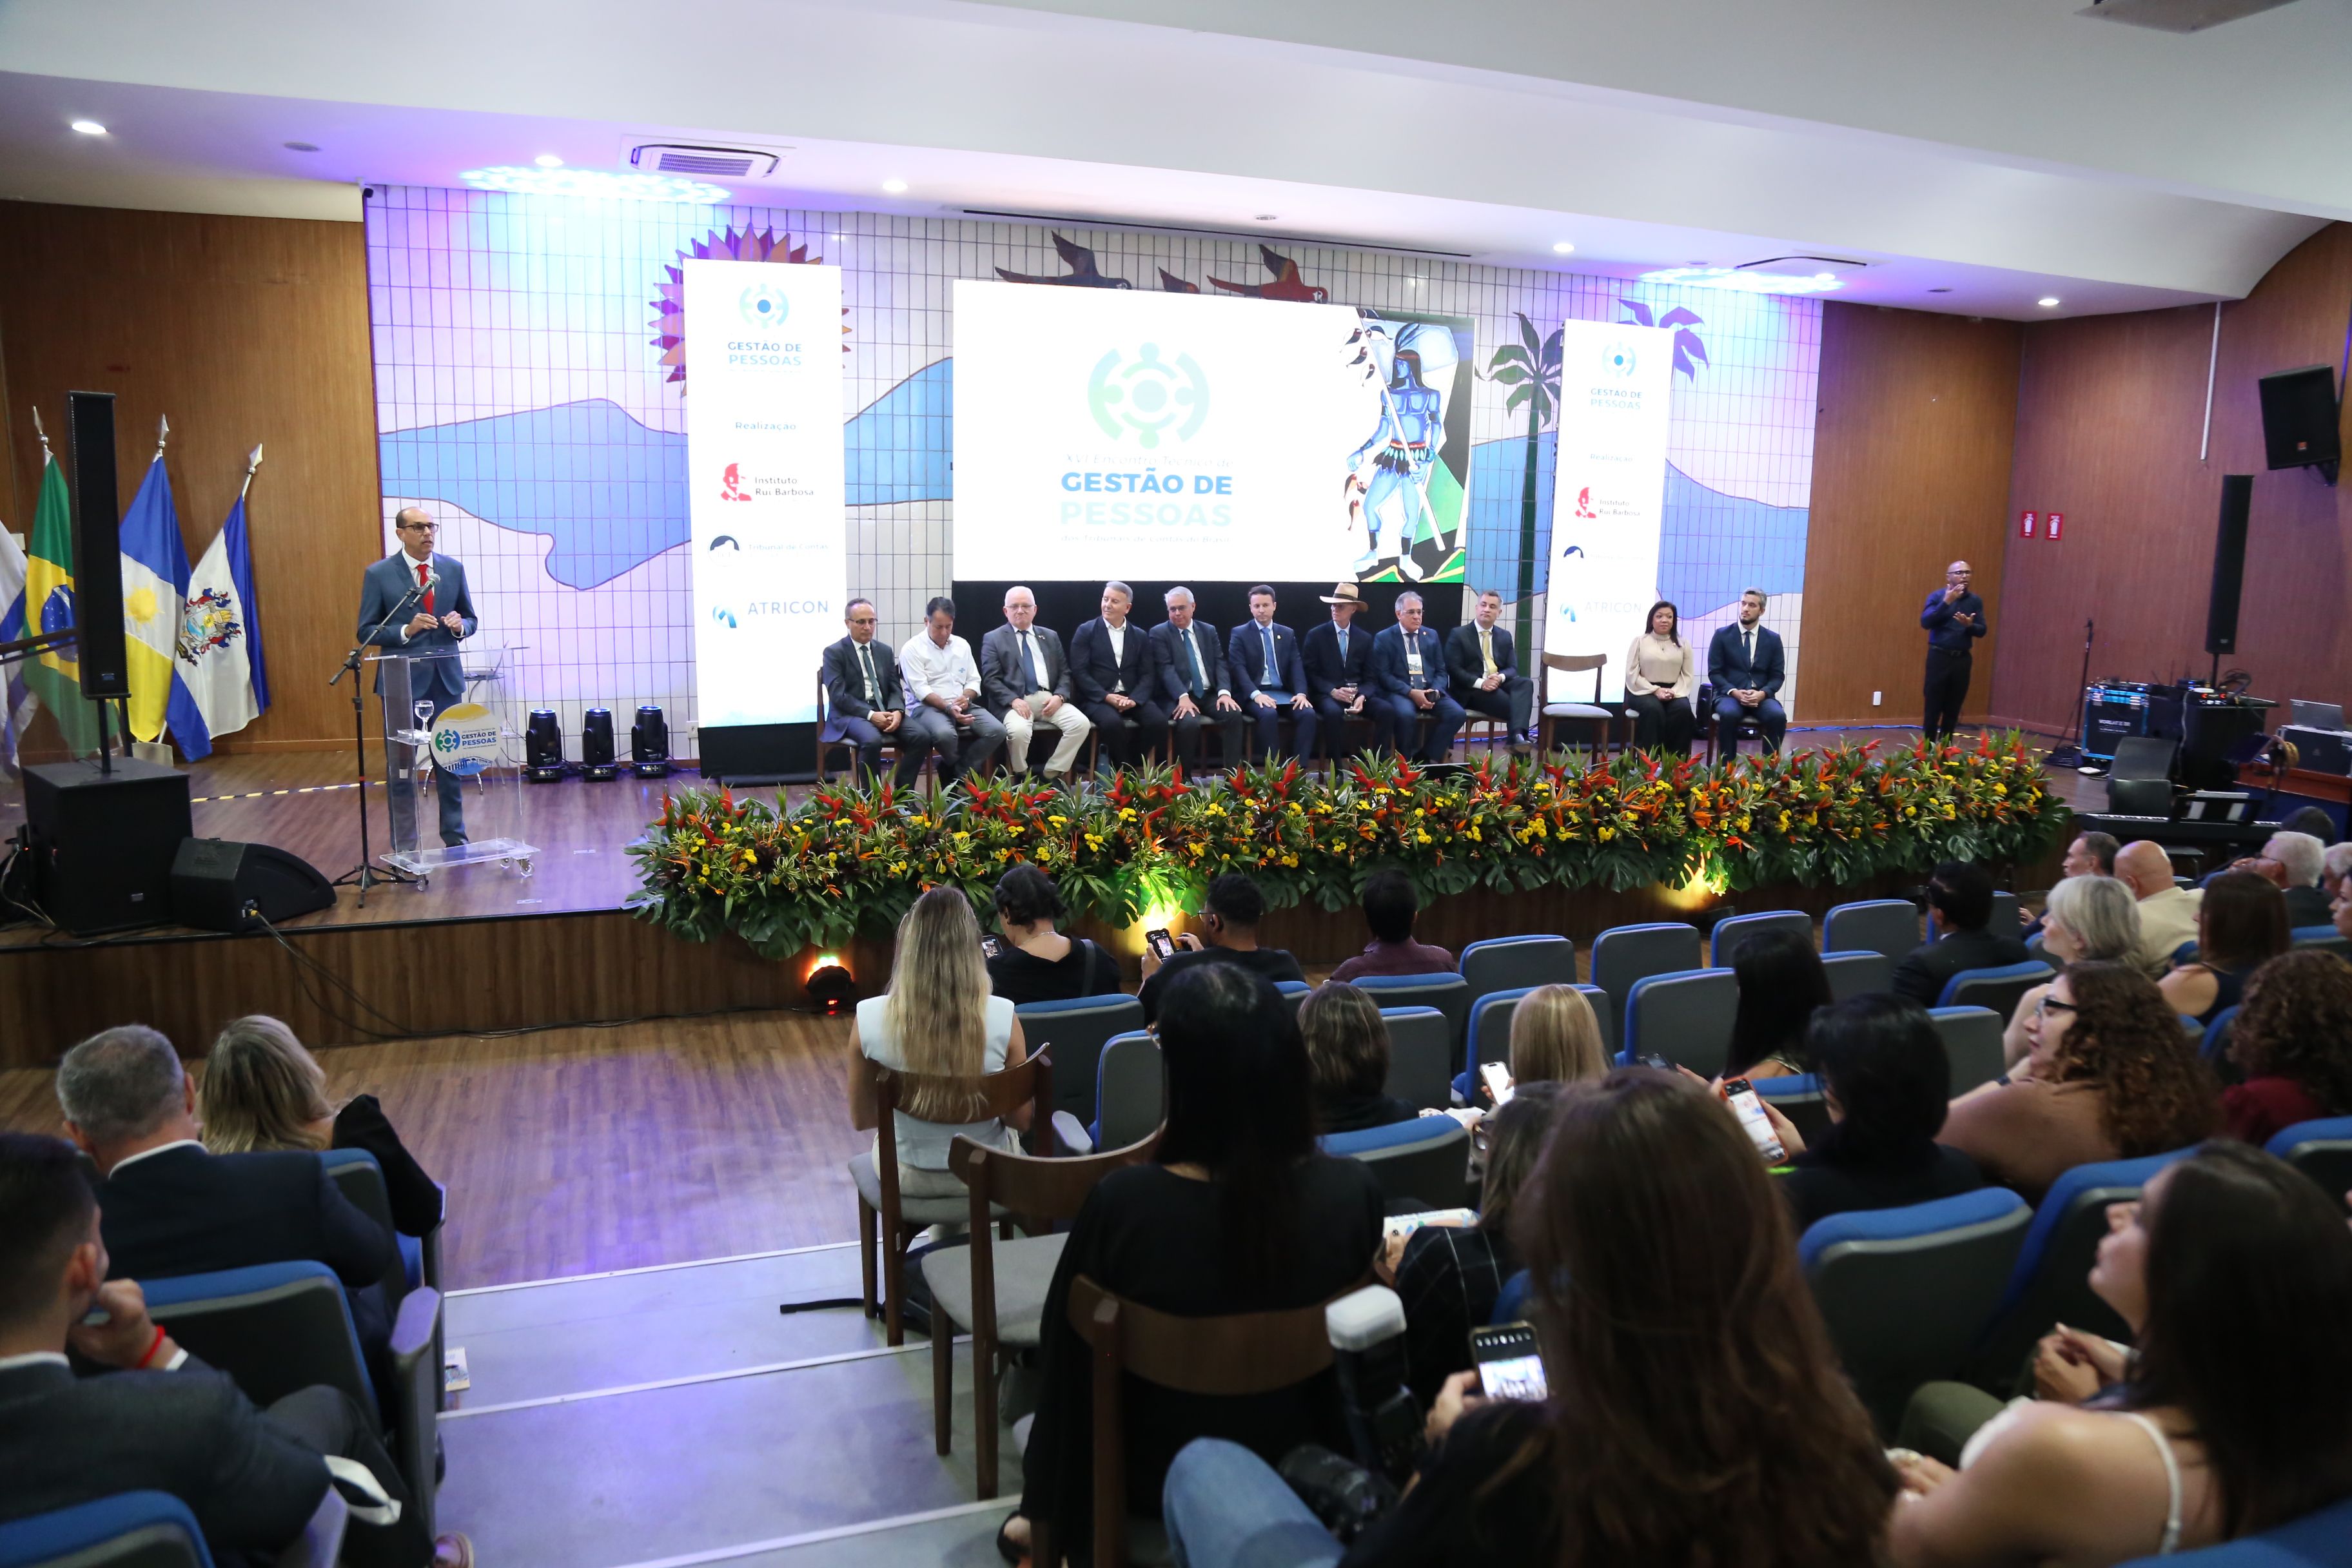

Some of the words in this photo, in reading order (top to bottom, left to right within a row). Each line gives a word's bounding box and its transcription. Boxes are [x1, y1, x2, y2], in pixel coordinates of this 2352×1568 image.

[785, 343, 801, 352] DE
[729, 355, 801, 366] PESSOAS
[1591, 398, 1641, 409] PESSOAS
[1061, 467, 1184, 494] GESTÃO
[1193, 475, 1233, 496] DE
[1061, 501, 1232, 527] PESSOAS
[747, 600, 828, 615] ATRICON
[1585, 602, 1642, 613] ATRICON
[462, 738, 496, 746] PESSOAS
